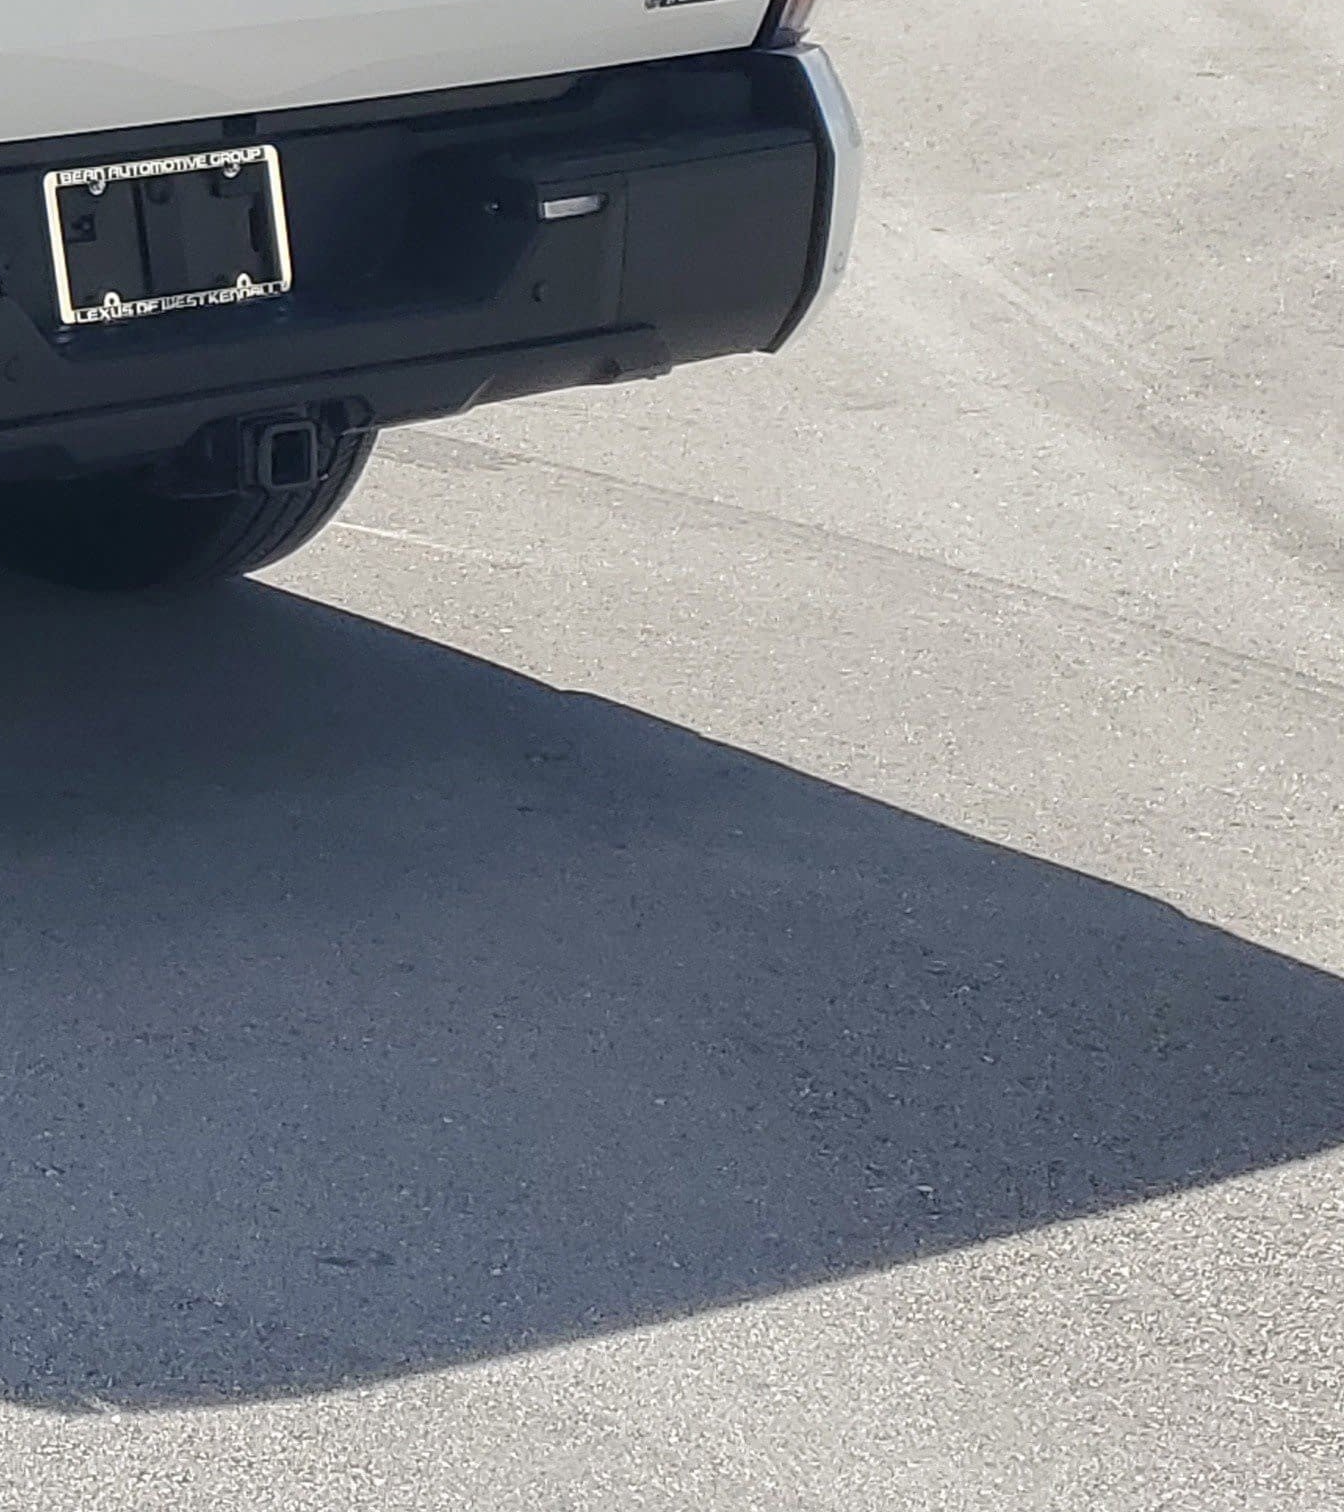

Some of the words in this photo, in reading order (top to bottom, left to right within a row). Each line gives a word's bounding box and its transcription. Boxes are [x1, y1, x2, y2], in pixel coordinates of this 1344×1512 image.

[60, 168, 104, 186] BEAN
[108, 159, 207, 180] AUTOMOTIVE
[211, 149, 261, 166] GROUP
[76, 303, 135, 323] LEXUS
[136, 300, 160, 315] OF
[162, 291, 206, 311] WEST
